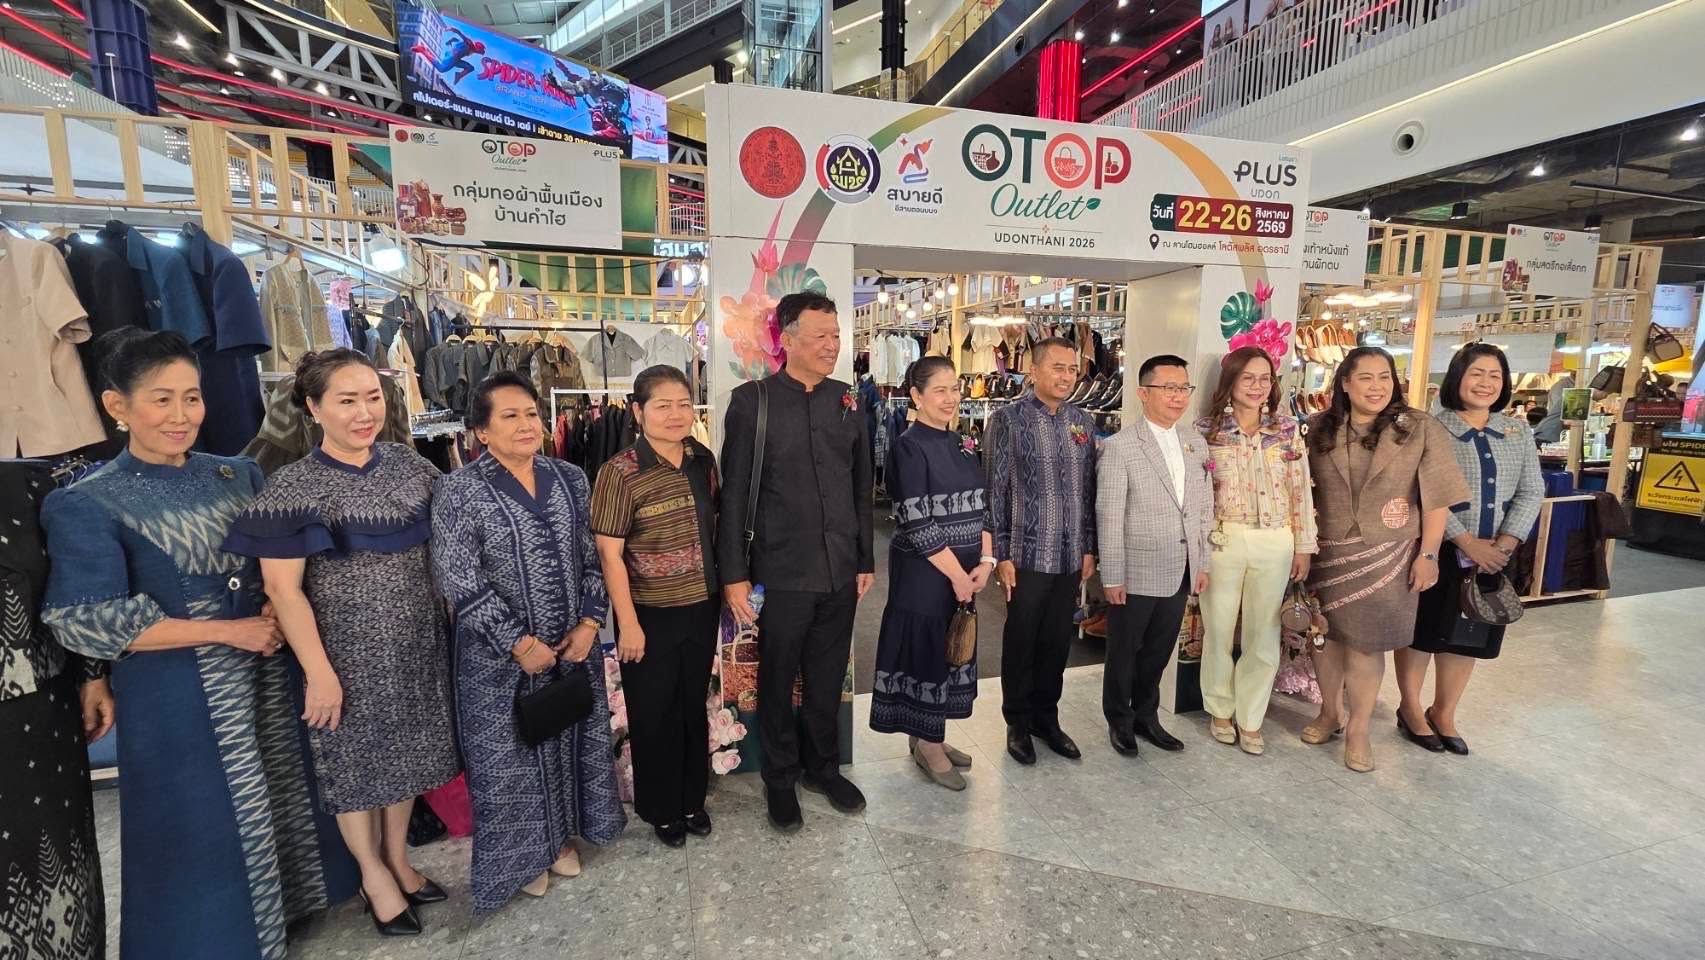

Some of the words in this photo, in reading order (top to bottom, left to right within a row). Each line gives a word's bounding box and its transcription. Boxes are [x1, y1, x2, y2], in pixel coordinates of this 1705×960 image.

[482, 139, 536, 157] OTOP
[593, 149, 618, 158] PLUS
[962, 124, 1132, 189] OTOP
[1233, 160, 1297, 187] PLUS
[453, 180, 603, 208] กลุ่มทอผ้าพื้นเมือง
[887, 186, 943, 204] สบายดี
[990, 183, 1085, 220] Outlet
[494, 205, 567, 226] บ้านคำไฮ
[1152, 202, 1174, 219] วันที่
[1178, 200, 1252, 231] 22-26
[1255, 207, 1290, 220] สิงหาคม
[1256, 221, 1286, 234] 2569
[994, 232, 1065, 247] UDONTHANI
[1069, 237, 1095, 248] 2026
